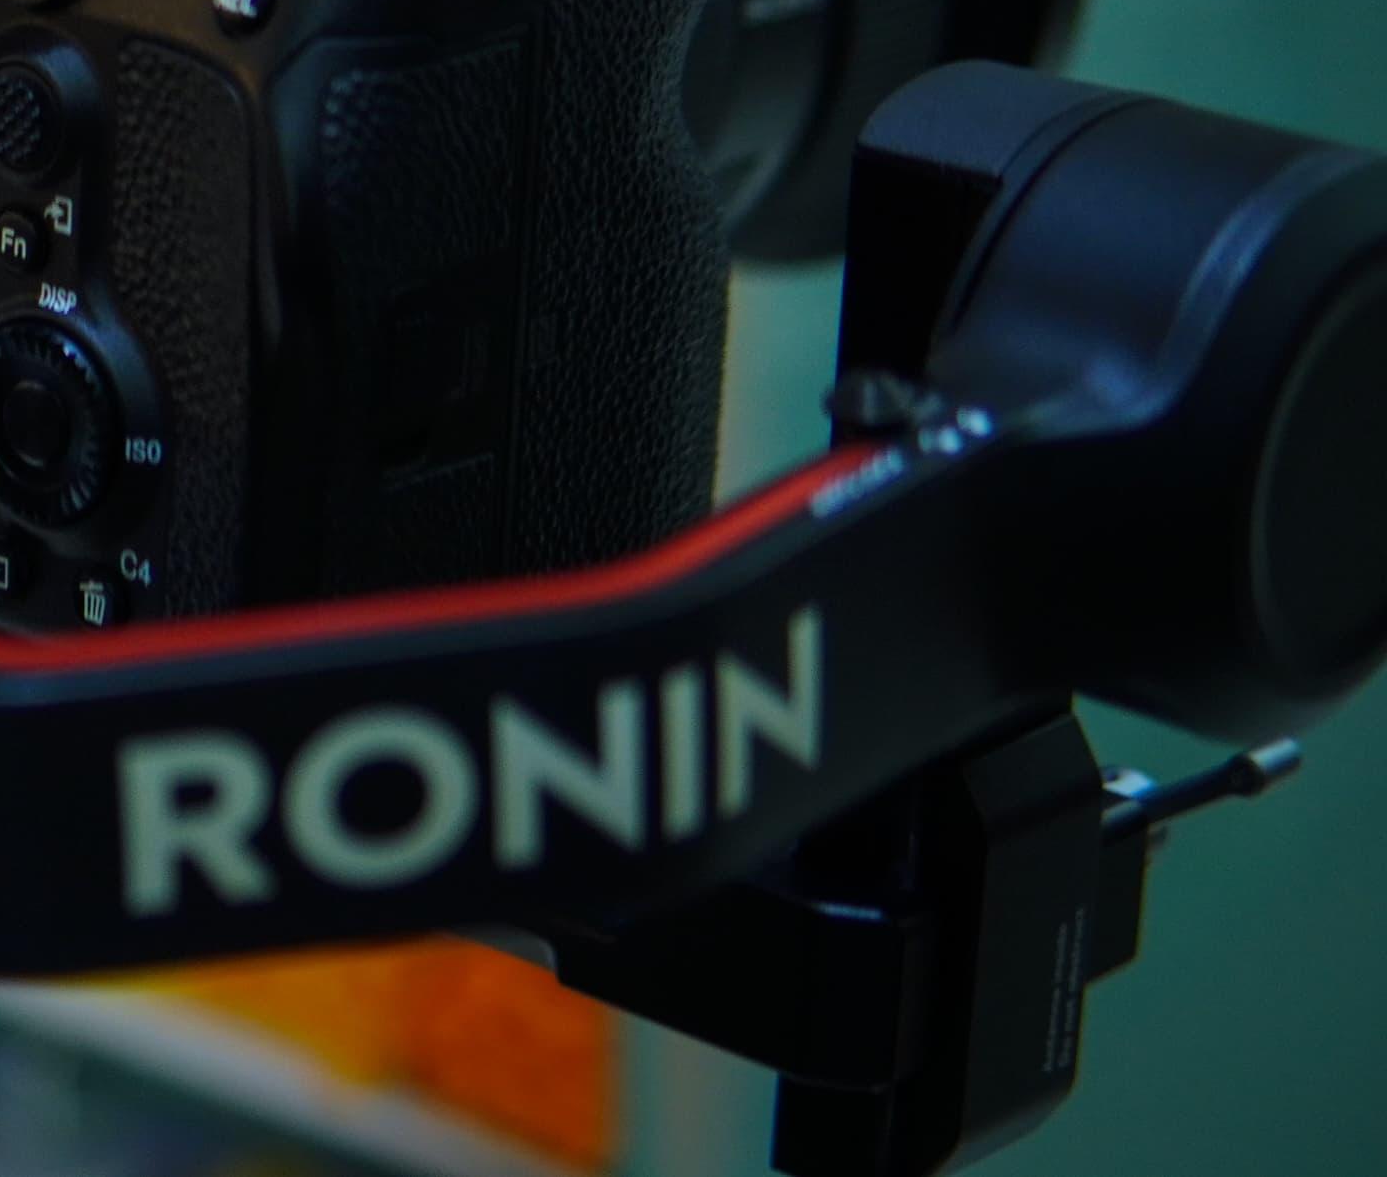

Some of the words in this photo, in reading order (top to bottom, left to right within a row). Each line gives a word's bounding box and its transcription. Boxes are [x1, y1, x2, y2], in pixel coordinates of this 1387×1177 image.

[0, 228, 27, 260] Fn
[38, 282, 77, 315] DISP
[126, 438, 162, 466] ISO
[120, 549, 152, 588] C4
[116, 603, 824, 917] RONIN
